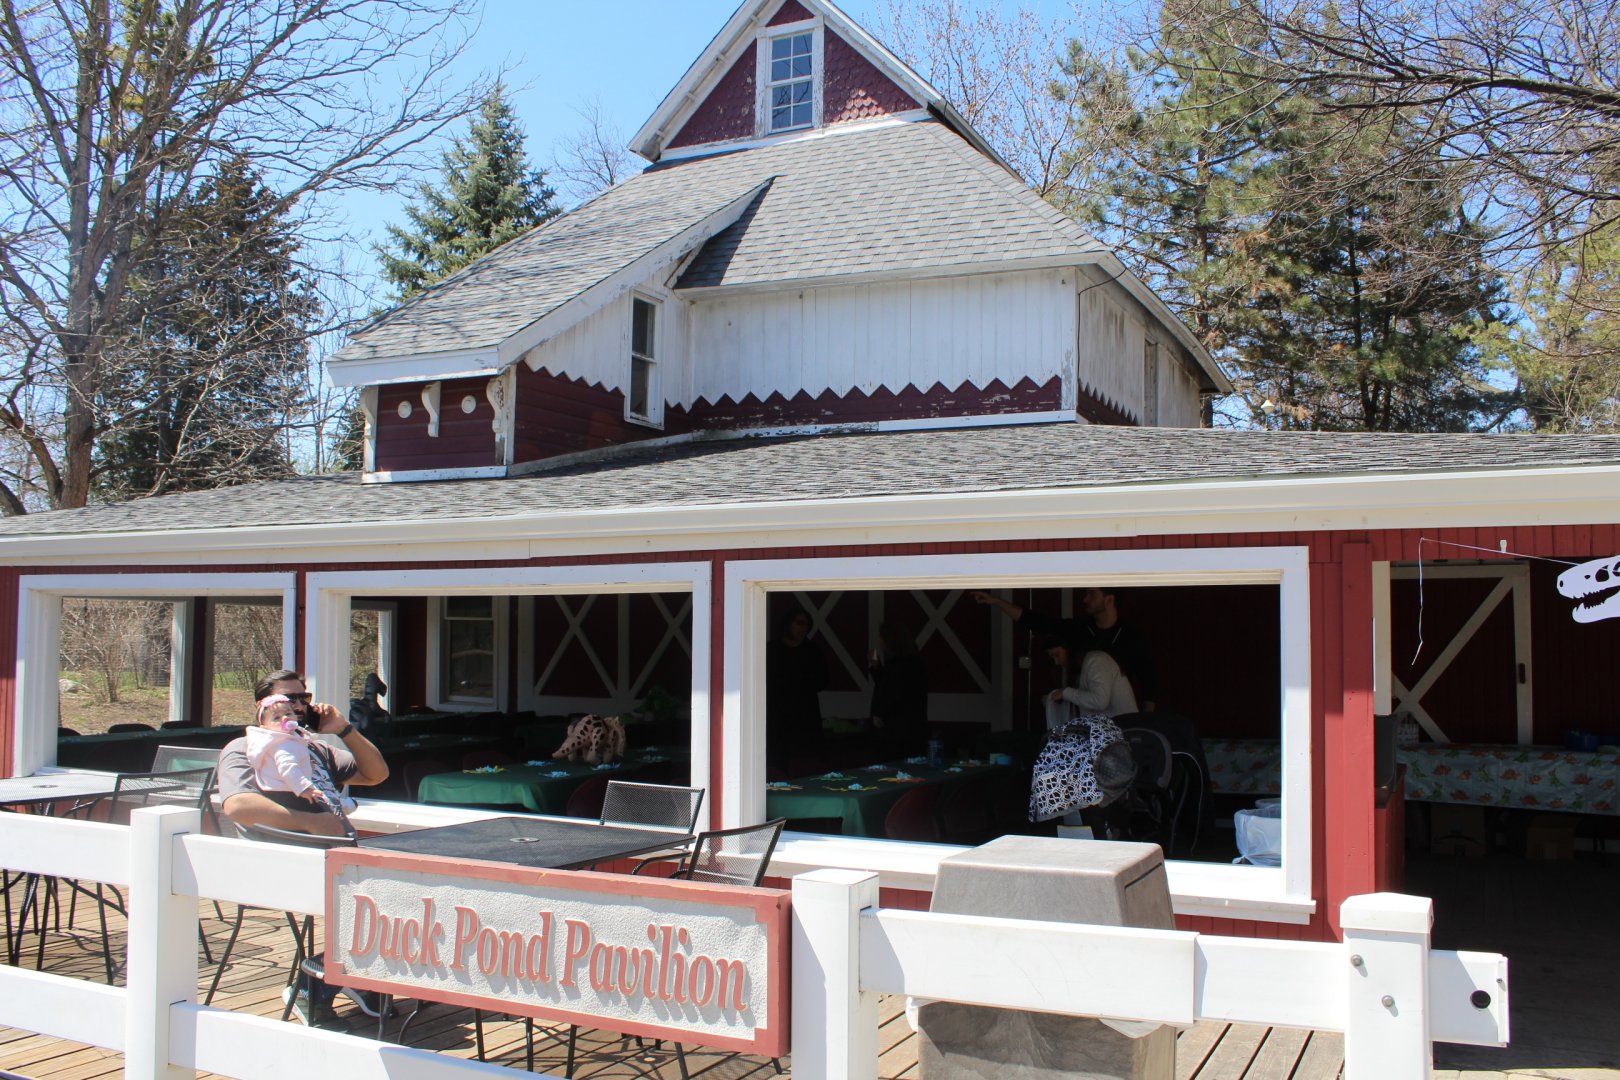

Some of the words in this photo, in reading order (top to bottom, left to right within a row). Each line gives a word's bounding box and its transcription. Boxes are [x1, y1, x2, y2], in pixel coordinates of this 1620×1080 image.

[348, 894, 444, 967] Duck
[450, 905, 552, 985] Pond
[558, 919, 748, 1011] Pavilion
